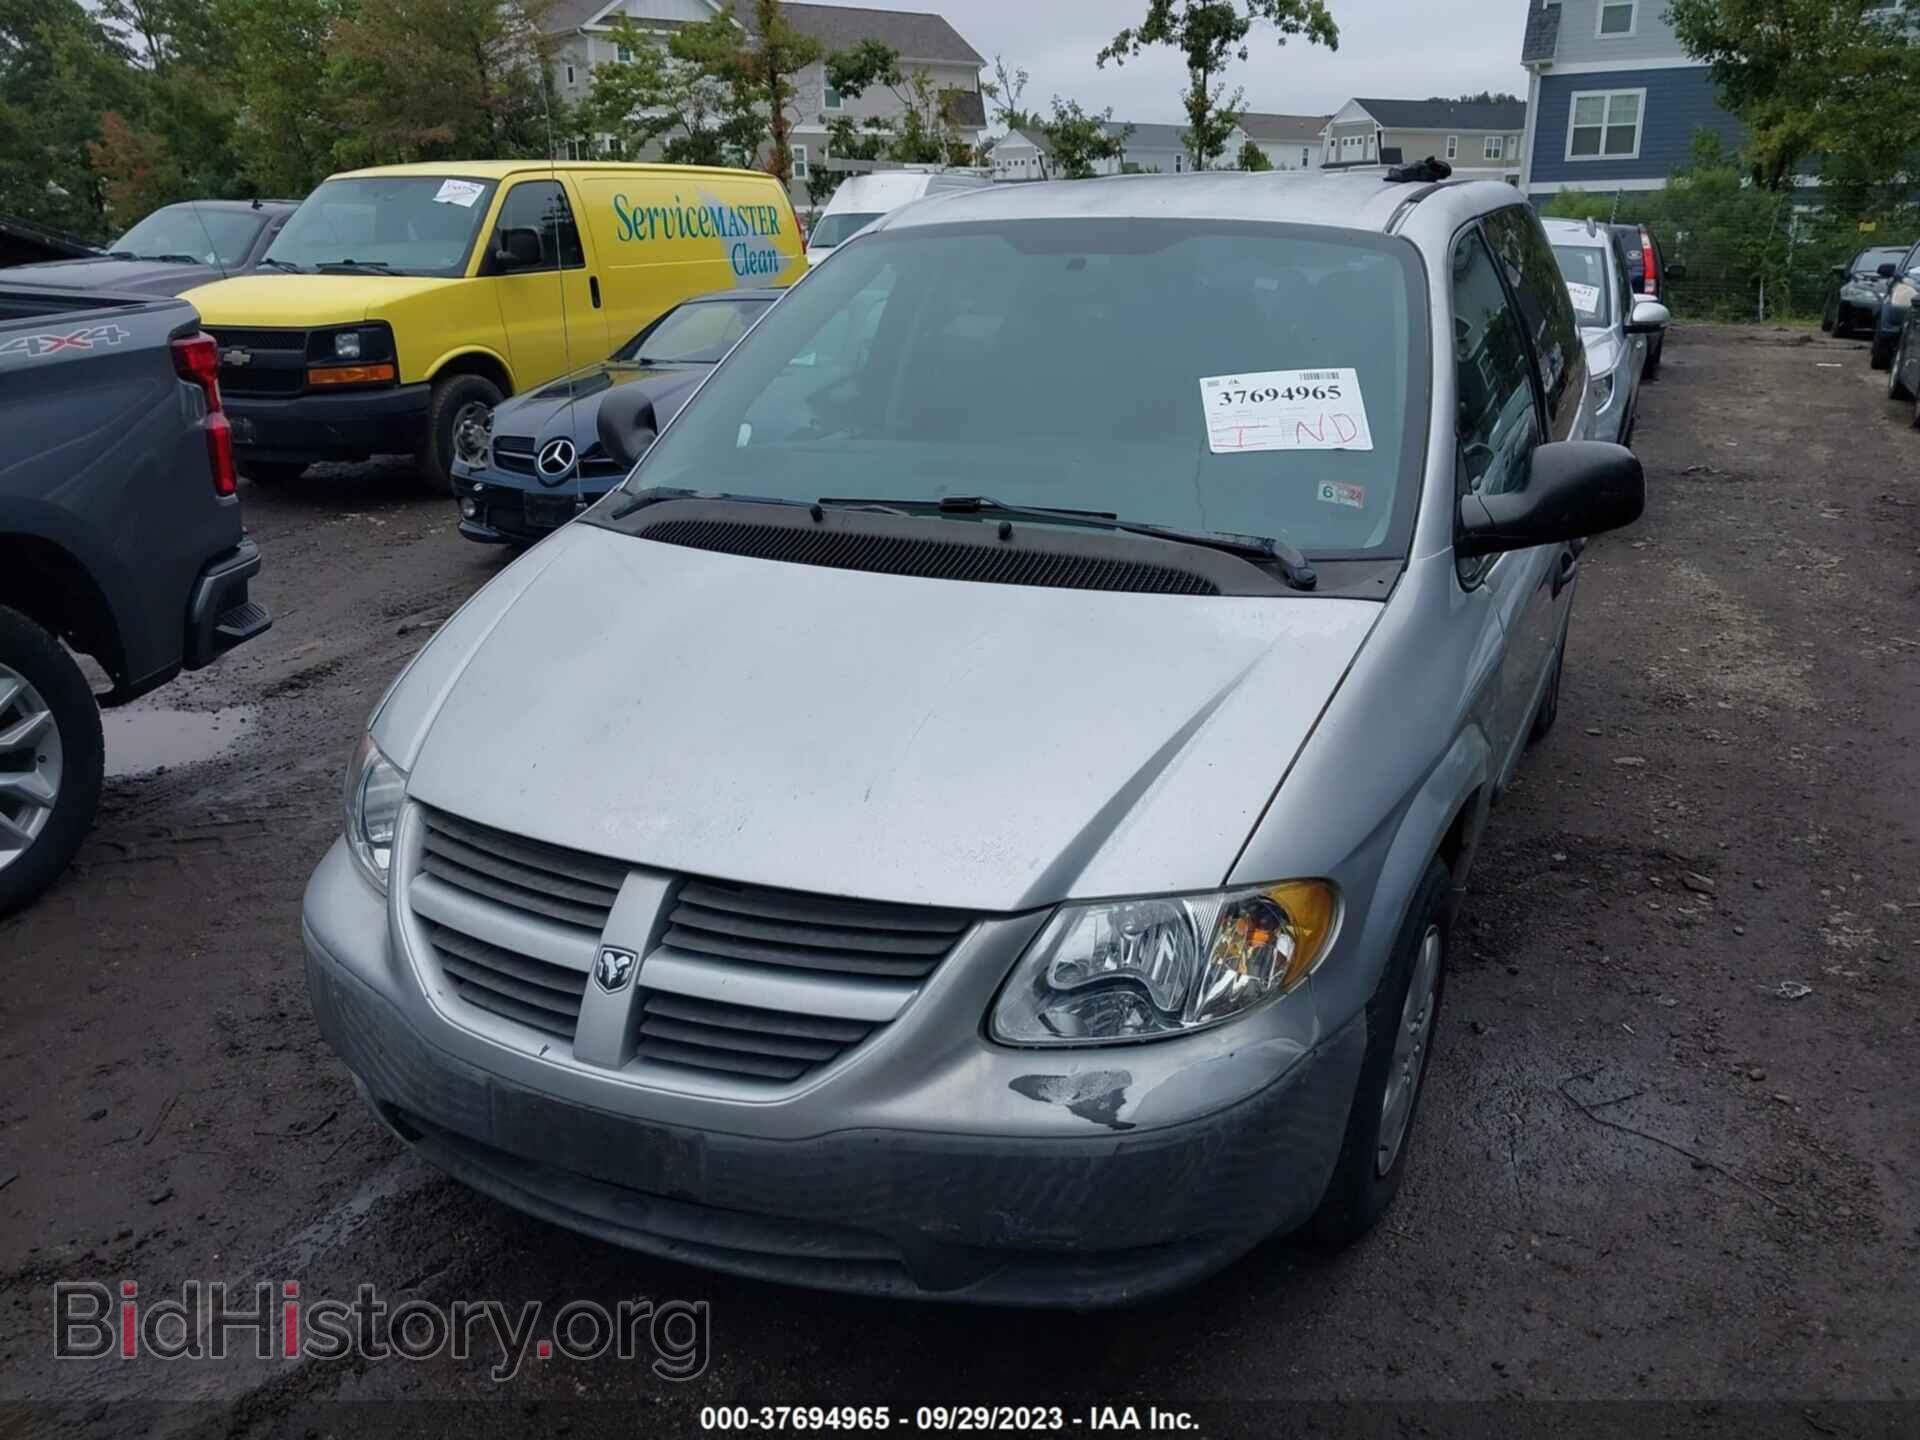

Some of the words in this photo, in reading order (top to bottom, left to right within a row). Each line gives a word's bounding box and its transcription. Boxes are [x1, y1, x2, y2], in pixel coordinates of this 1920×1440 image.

[731, 242, 779, 276] Clean
[1218, 384, 1342, 406] 37694965
[1322, 485, 1334, 498] 6
